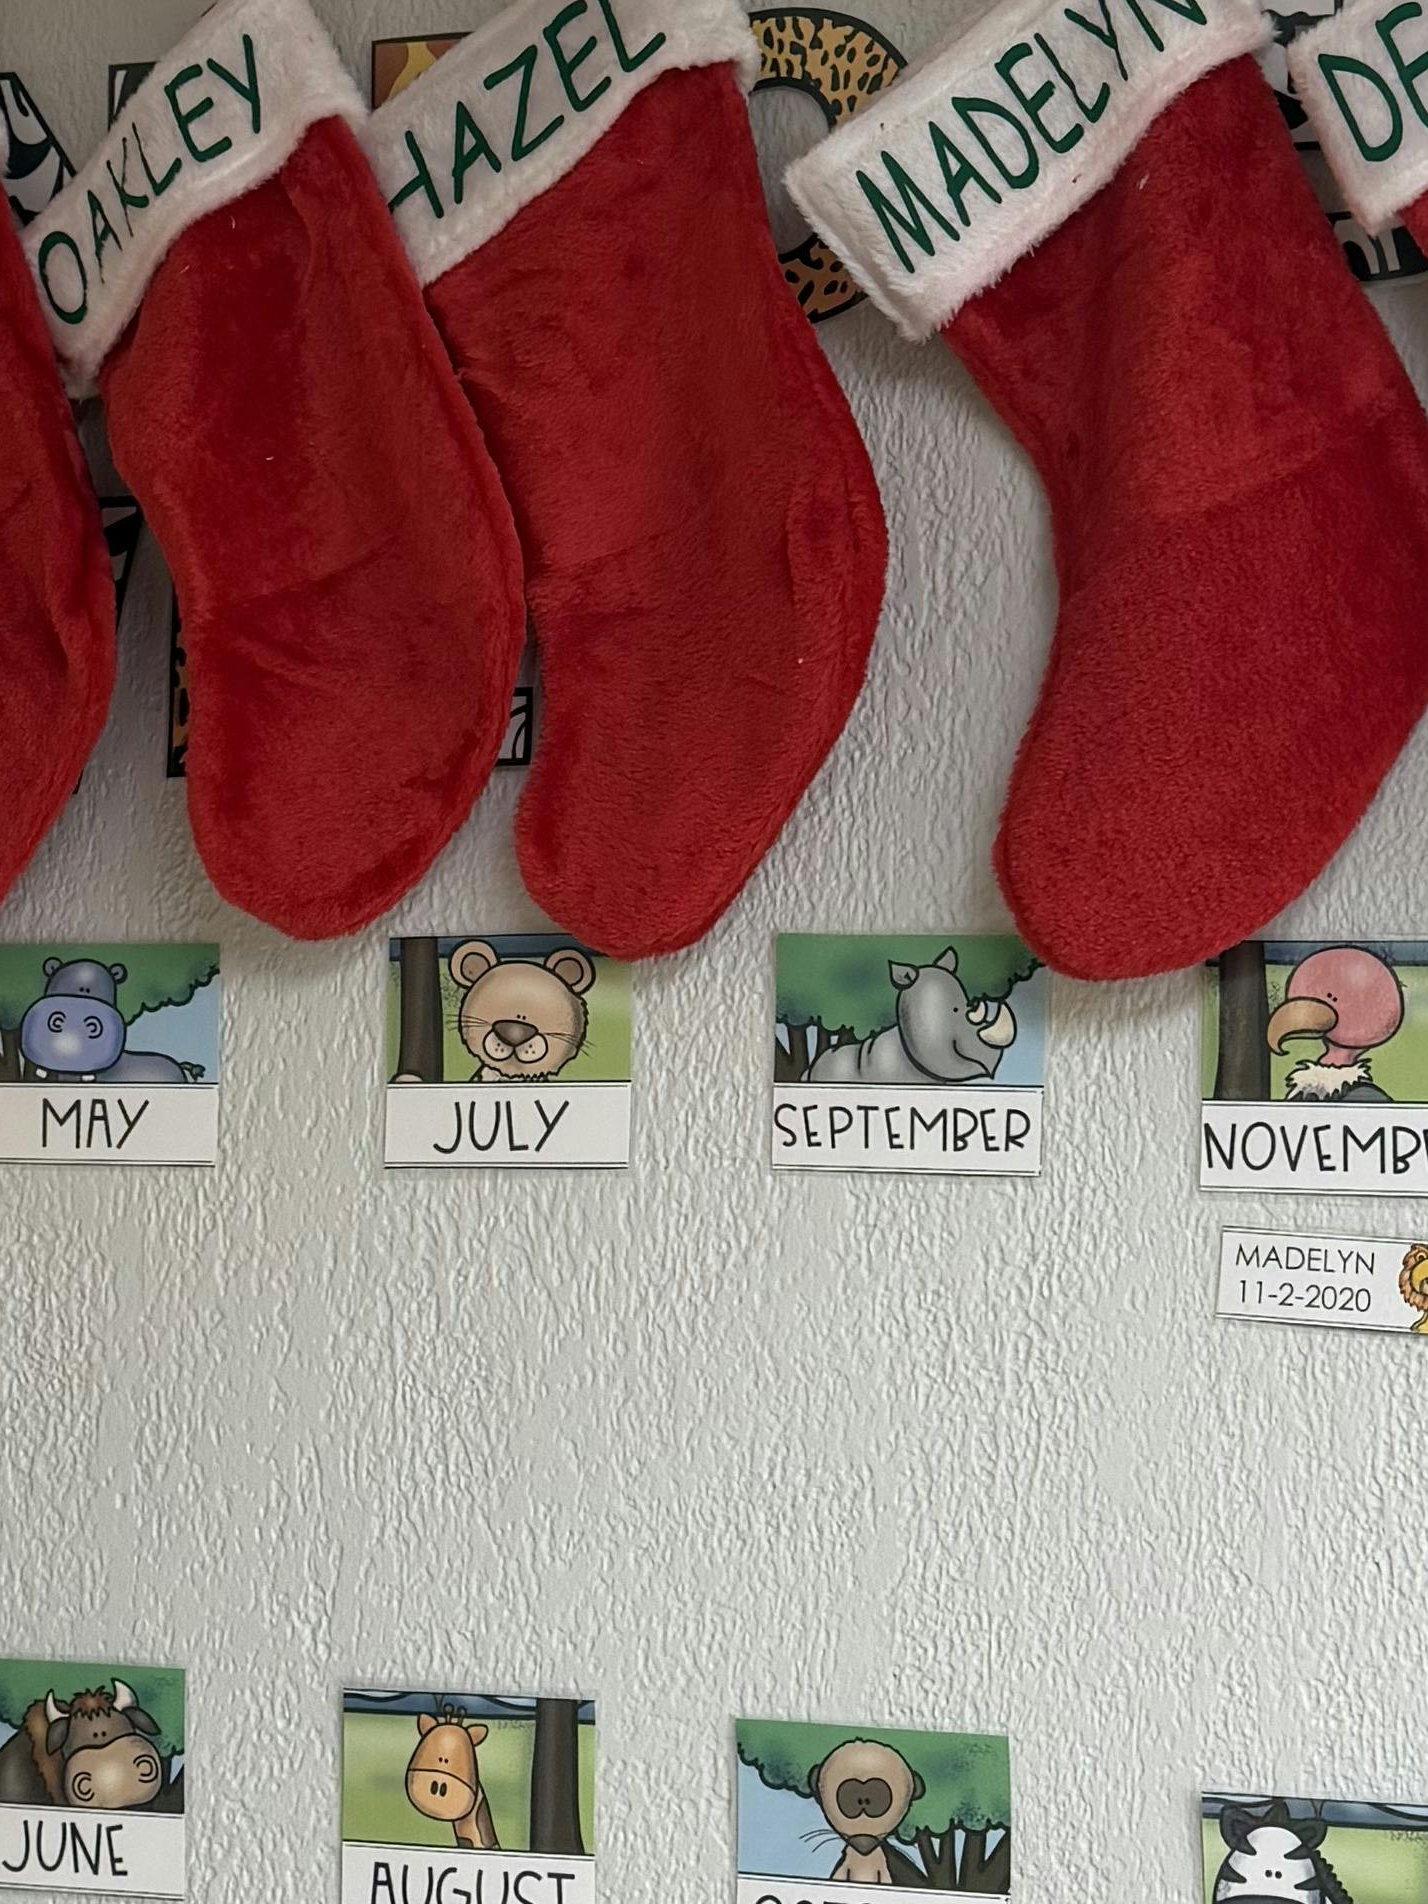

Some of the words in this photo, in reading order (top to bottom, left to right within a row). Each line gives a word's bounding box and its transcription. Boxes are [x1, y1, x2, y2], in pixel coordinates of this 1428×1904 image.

[36, 34, 263, 326] OAKLEY
[42, 1098, 149, 1149] MAY
[433, 1100, 569, 1154] JULY
[774, 1104, 1030, 1151] SEPTEMBER
[1236, 1244, 1374, 1275] MADELYN
[1240, 1280, 1370, 1312] 11-2-2020
[2, 1820, 128, 1876] JUNE
